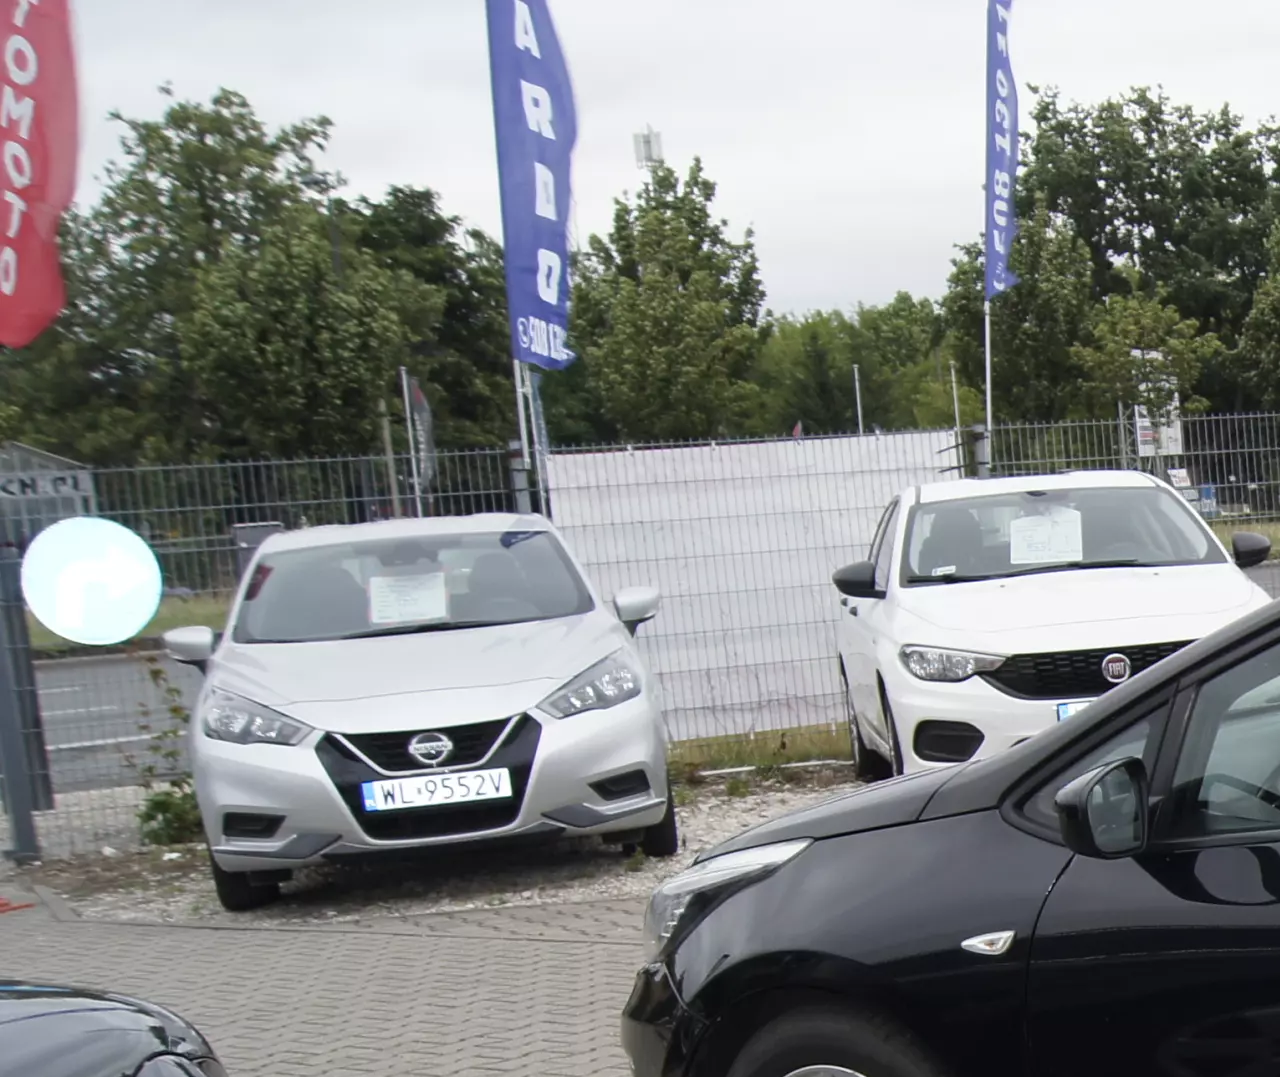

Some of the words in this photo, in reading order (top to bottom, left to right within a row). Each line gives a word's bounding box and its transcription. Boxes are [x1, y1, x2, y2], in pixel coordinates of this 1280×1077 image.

[1108, 661, 1125, 677] FIAT
[380, 781, 415, 806] WL
[424, 772, 502, 802] 9552V
